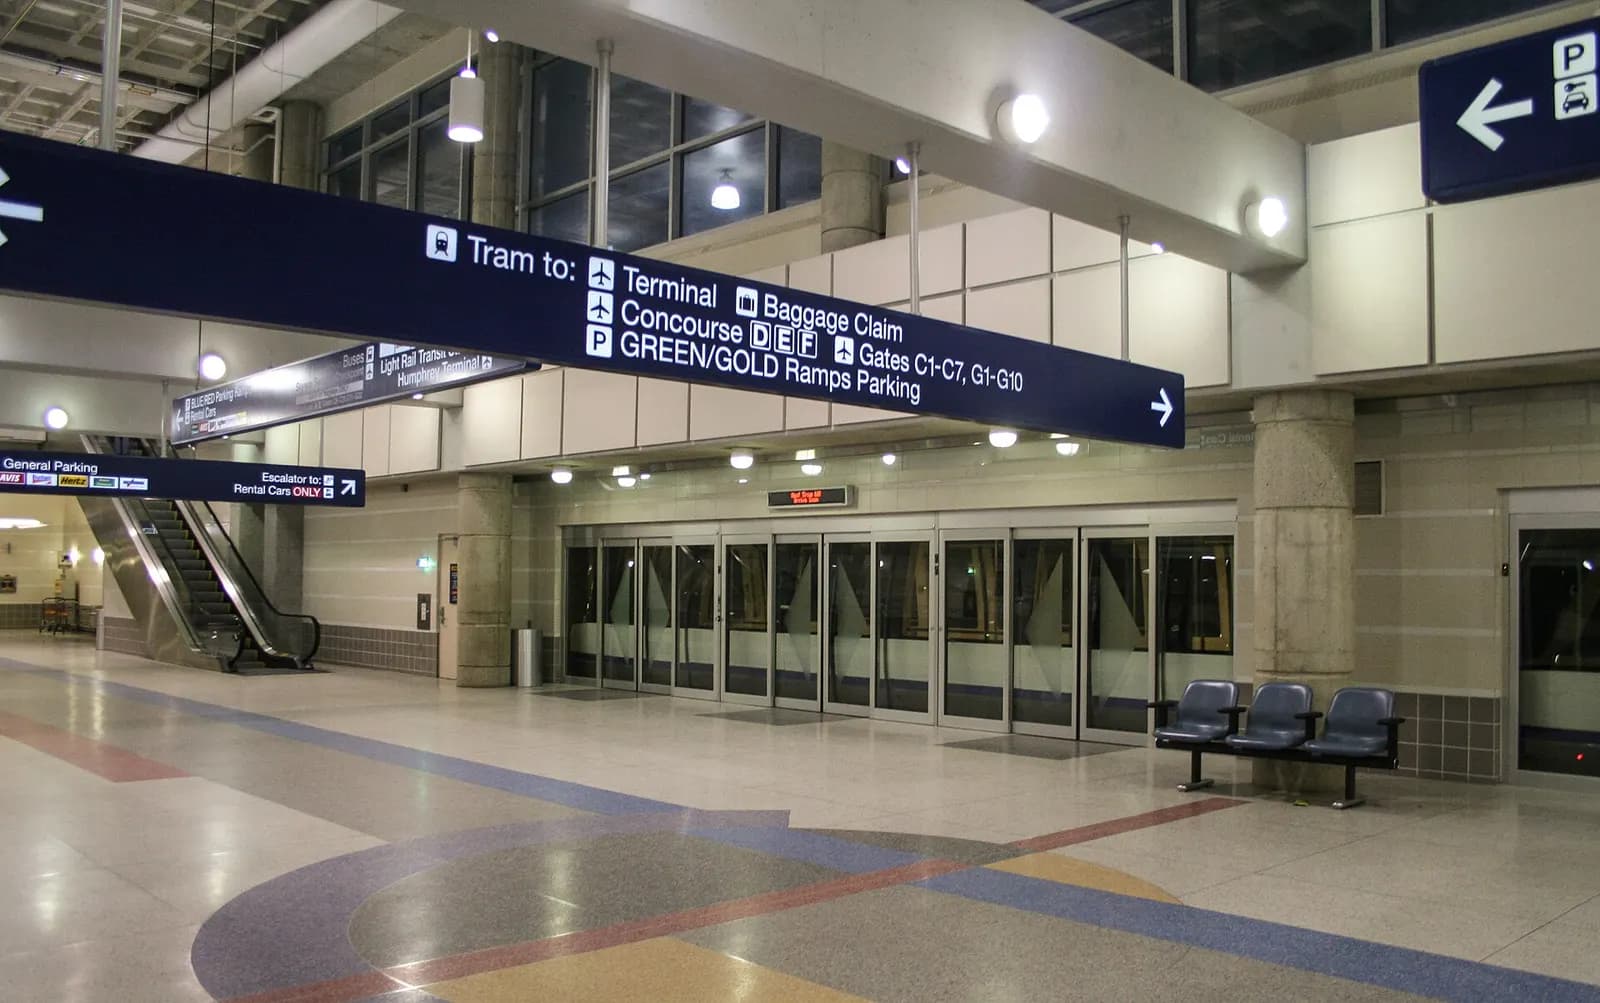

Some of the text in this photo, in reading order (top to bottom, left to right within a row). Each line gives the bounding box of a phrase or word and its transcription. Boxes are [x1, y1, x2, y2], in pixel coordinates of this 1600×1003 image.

[1564, 44, 1584, 71] P
[467, 235, 576, 281] Tram to:
[623, 265, 903, 343] Terminal Baggage Claim
[620, 300, 743, 341] Concourse
[752, 324, 769, 347] D
[777, 328, 792, 351] E
[859, 343, 910, 373] Gates
[914, 353, 966, 386] C1-C7,
[971, 364, 1023, 392] G1-G10
[343, 352, 365, 368] Buses
[380, 355, 400, 376] Light
[401, 351, 416, 369] Rail
[593, 331, 920, 405] P GREEN/GOLD Ramps Parking
[398, 355, 480, 387] Humphrey Terminal
[216, 390, 234, 403] Parking
[191, 408, 205, 422] Rental
[206, 407, 217, 418] Cars
[3, 458, 99, 475] General Parking
[0, 473, 21, 483] AVIS
[60, 476, 87, 486] Hertz
[262, 472, 322, 485] Escalator to:
[234, 483, 321, 497] Rental Cars ONLY
